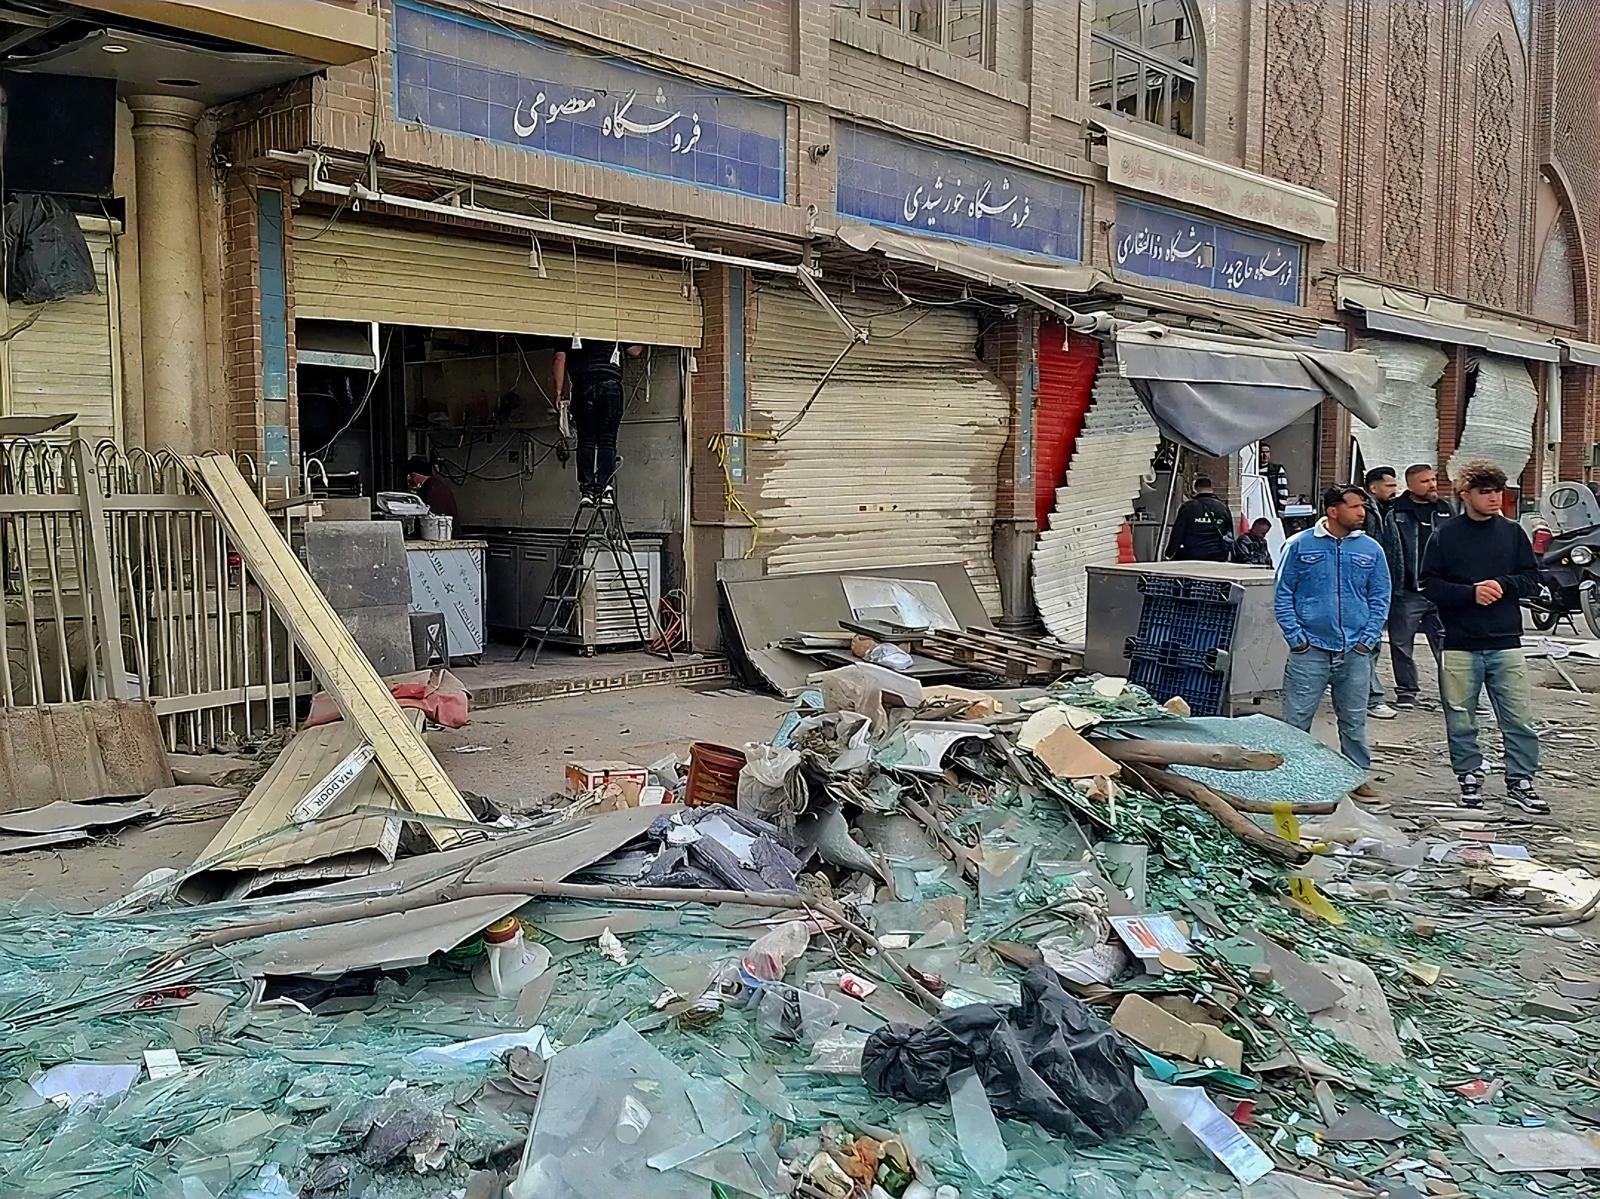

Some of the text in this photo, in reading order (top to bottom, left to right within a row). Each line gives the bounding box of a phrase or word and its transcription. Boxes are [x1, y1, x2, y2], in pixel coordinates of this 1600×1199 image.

[513, 87, 702, 154] فروشگاه معصومی
[904, 176, 1030, 228] فروشگاه خورشیدی
[1164, 226, 1209, 269] وشگاه
[1254, 248, 1292, 286] فروشگاه
[314, 768, 354, 807] ATA DOOR
